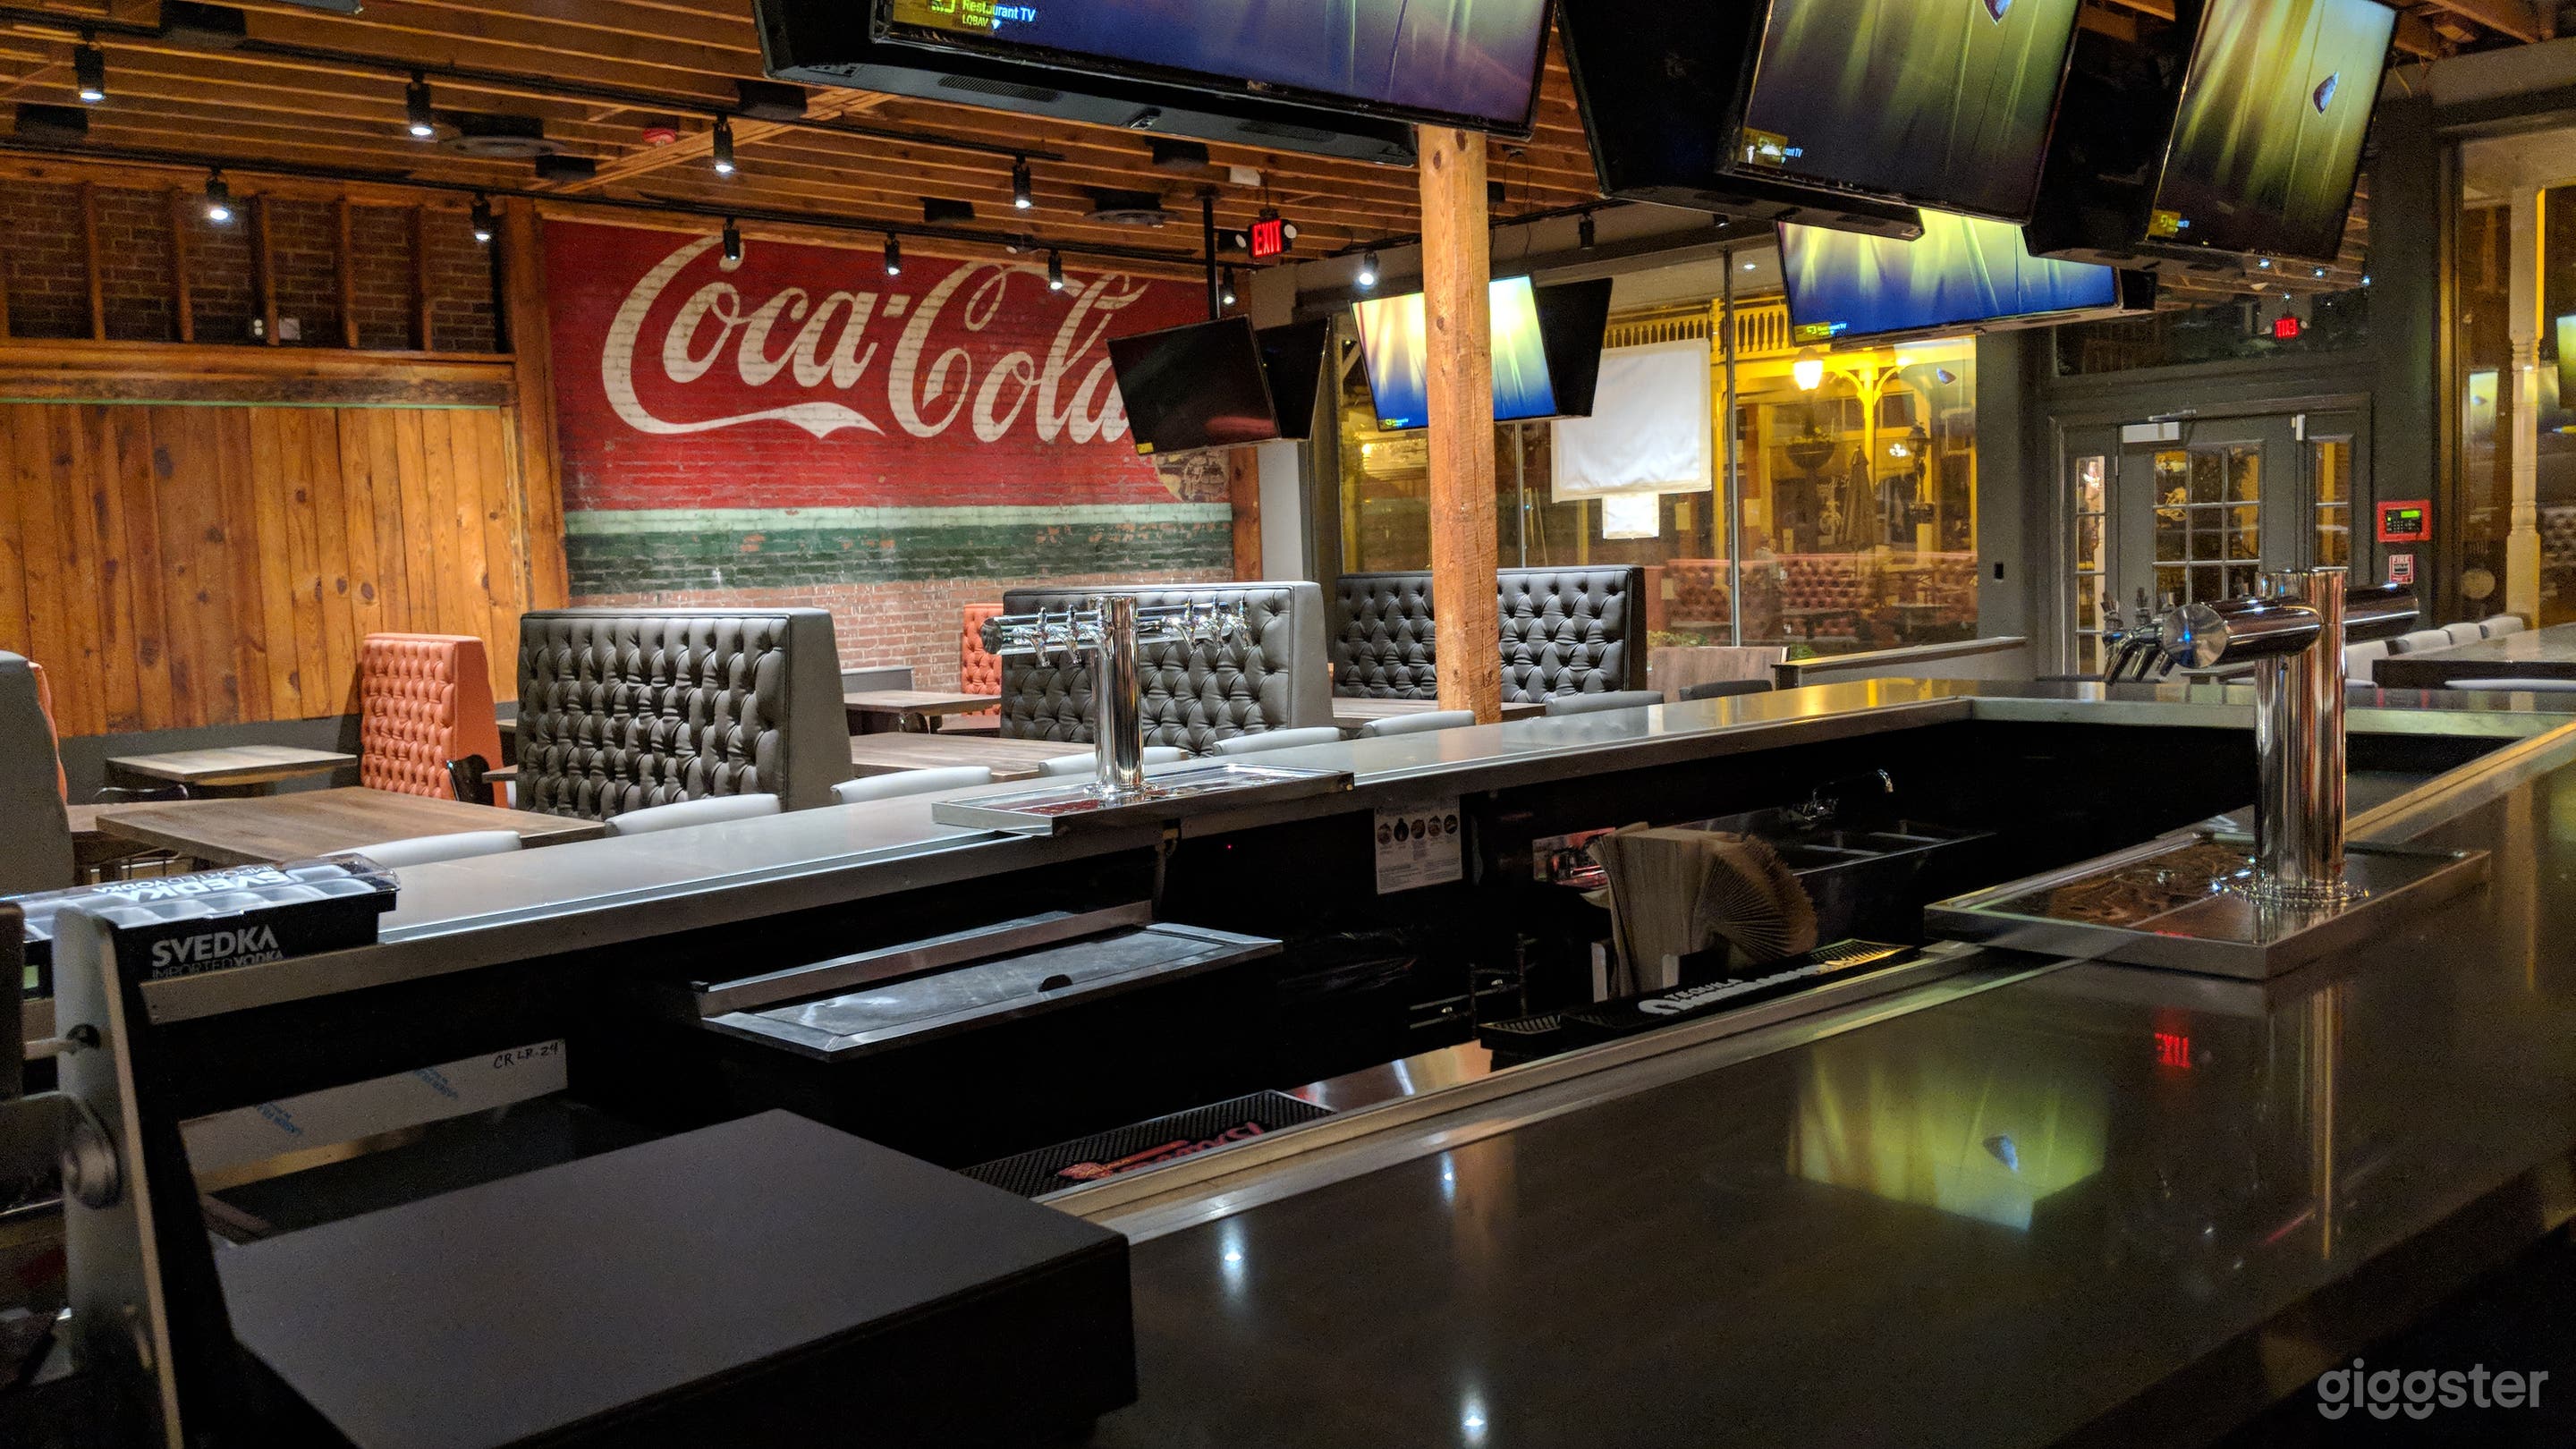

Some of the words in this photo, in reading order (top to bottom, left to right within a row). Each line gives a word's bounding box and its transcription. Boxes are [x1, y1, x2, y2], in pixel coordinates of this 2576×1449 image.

[1021, 6, 1036, 21] TV
[1253, 220, 1281, 256] EXIT
[107, 871, 289, 902] SVEDKA
[151, 924, 279, 968] SVEDKA
